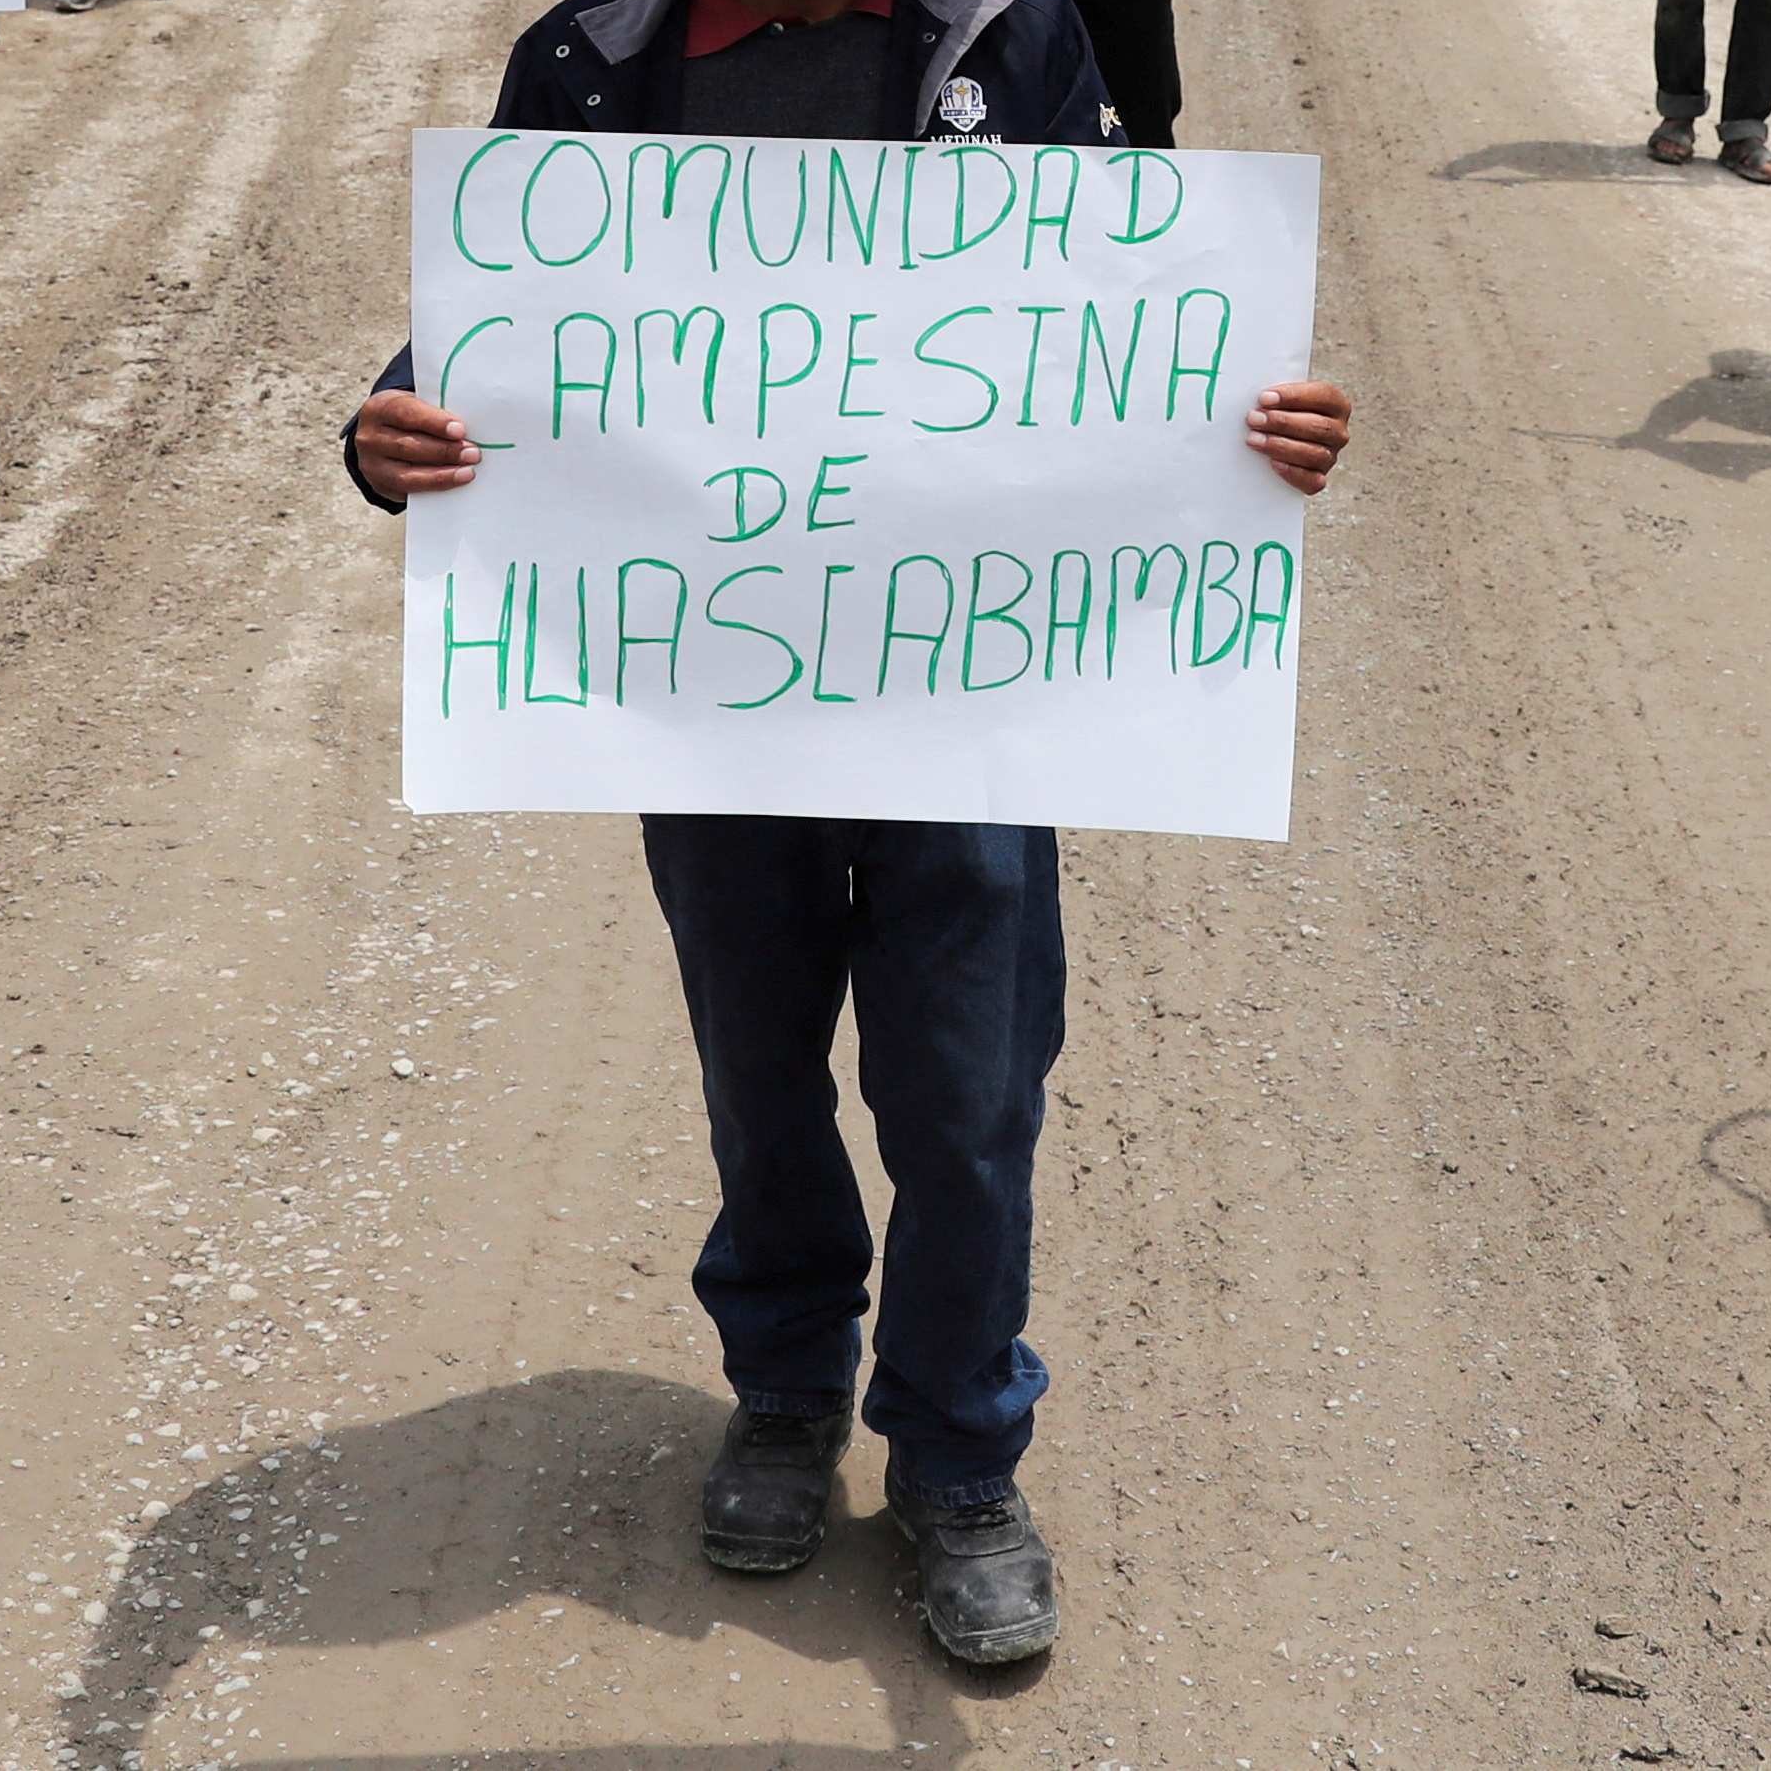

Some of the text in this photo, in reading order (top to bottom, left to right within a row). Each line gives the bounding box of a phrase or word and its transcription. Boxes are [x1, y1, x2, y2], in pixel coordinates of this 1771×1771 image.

[452, 133, 1184, 274] COMUNIDAD
[439, 287, 1231, 450] CAMPESINA
[702, 453, 871, 543] DE
[440, 538, 1294, 721] HUASCABAMBA
